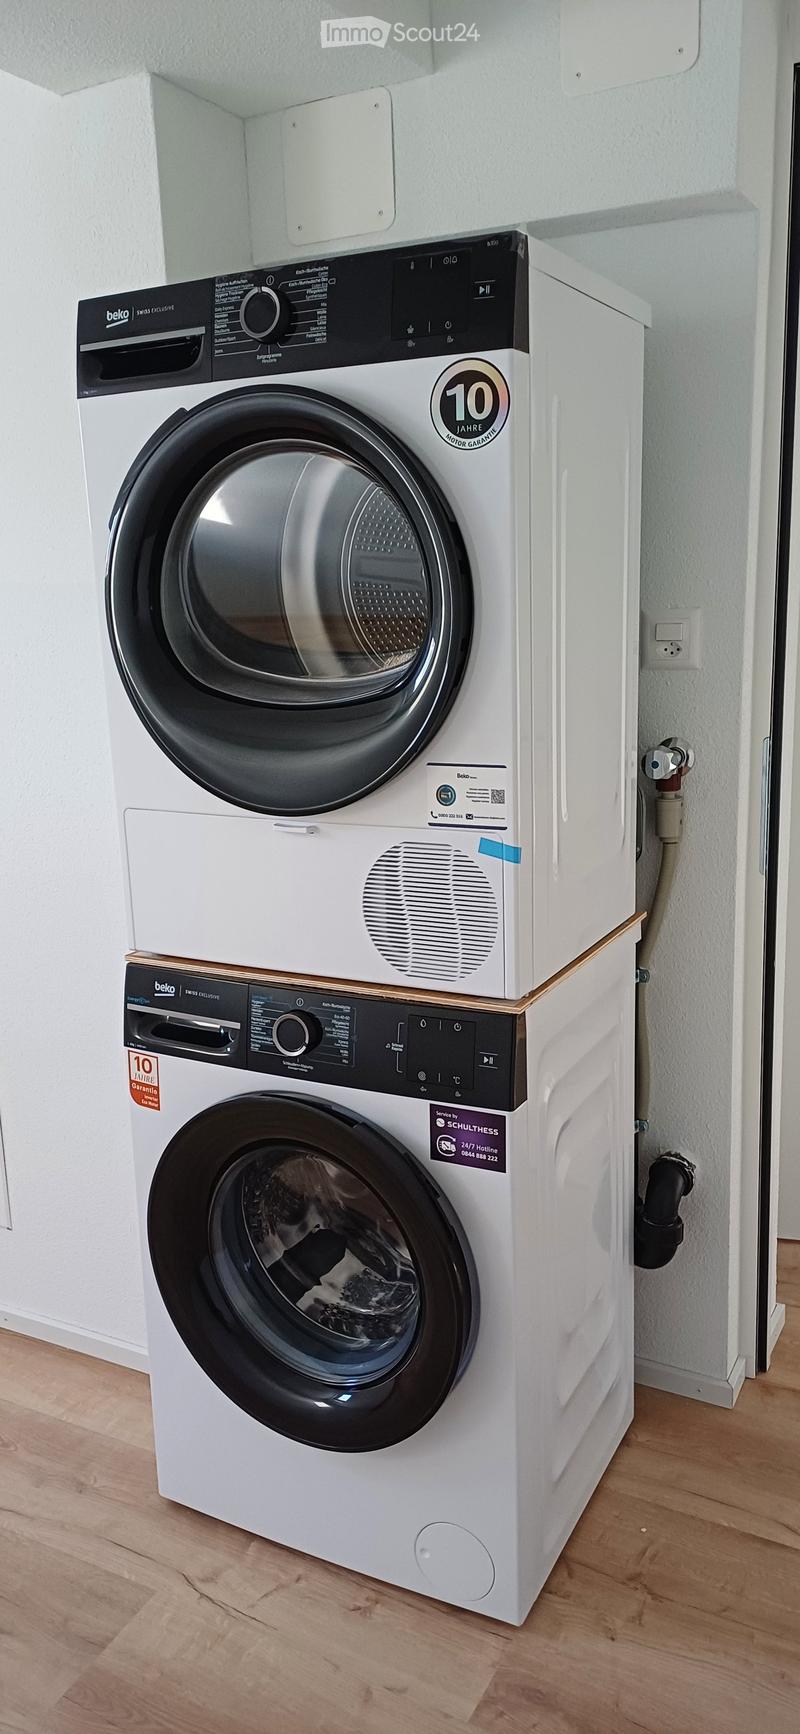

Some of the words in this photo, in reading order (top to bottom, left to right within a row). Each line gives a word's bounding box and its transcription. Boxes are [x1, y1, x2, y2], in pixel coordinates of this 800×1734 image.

[106, 308, 129, 321] beko
[446, 381, 493, 421] 10
[456, 423, 483, 434] JAHRE
[445, 433, 467, 447] MOTOR
[467, 427, 497, 448] GARANTIE
[154, 981, 175, 993] beko
[198, 990, 220, 1000] EXCLUSIVE
[134, 1056, 152, 1074] 10
[131, 1083, 158, 1095] Garantie
[447, 1121, 499, 1136] SCHULTHESS
[461, 1142, 475, 1150] 24/7
[476, 1144, 498, 1154] Hotline
[461, 1150, 475, 1158] 0844
